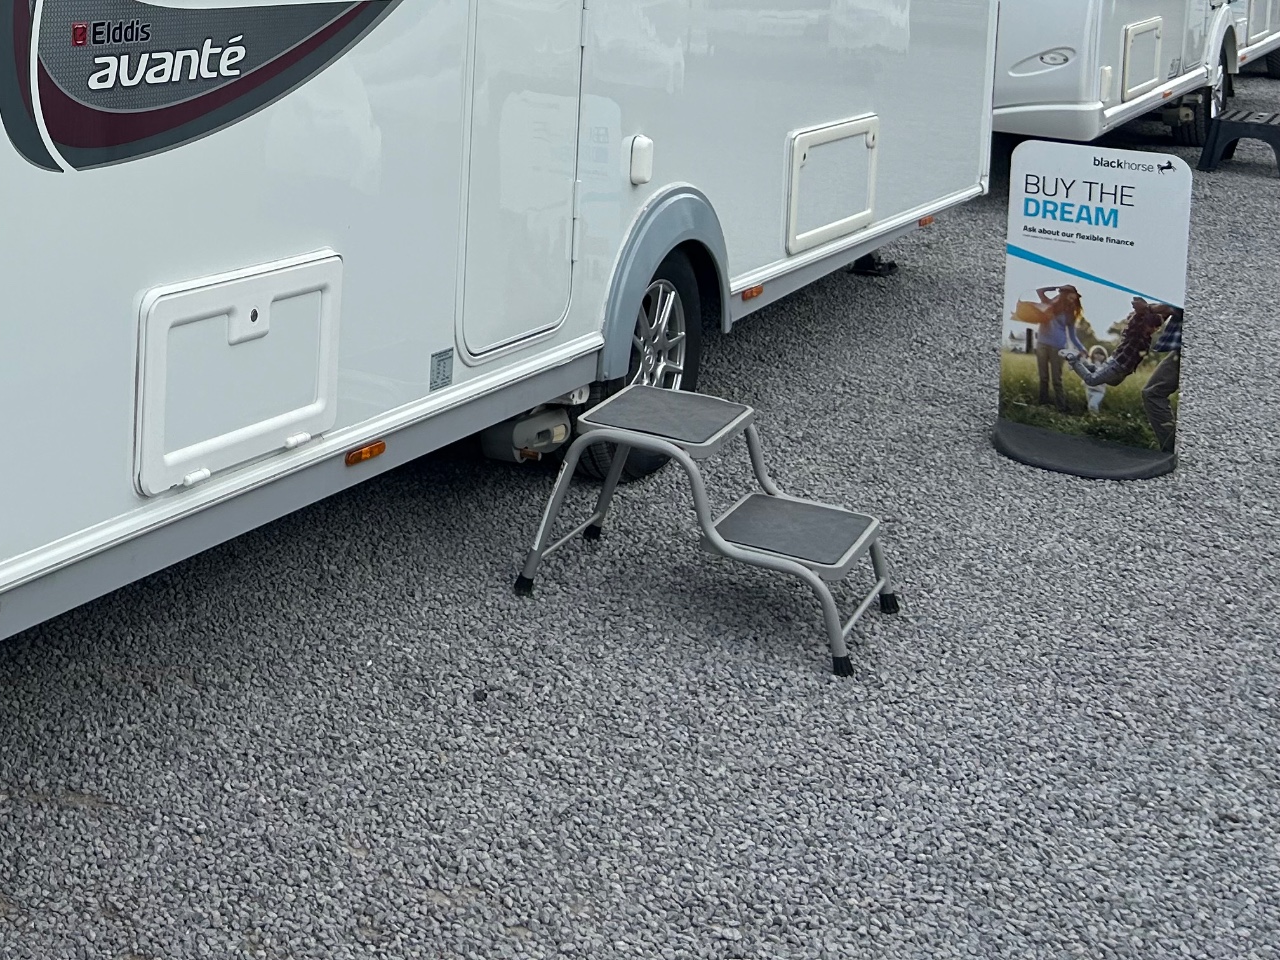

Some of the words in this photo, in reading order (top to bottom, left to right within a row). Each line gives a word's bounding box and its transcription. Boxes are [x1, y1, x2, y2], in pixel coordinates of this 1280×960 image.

[92, 20, 151, 45] Elddis
[88, 34, 246, 90] avanté
[1093, 156, 1155, 173] blackhorse
[1024, 174, 1076, 199] BUY
[1082, 181, 1136, 207] THE
[1023, 197, 1119, 228] DREAM
[1023, 225, 1037, 234] Ask
[1038, 227, 1060, 237] about
[1061, 231, 1074, 239] our
[1075, 232, 1104, 243] flexible
[1105, 236, 1135, 247] finance
